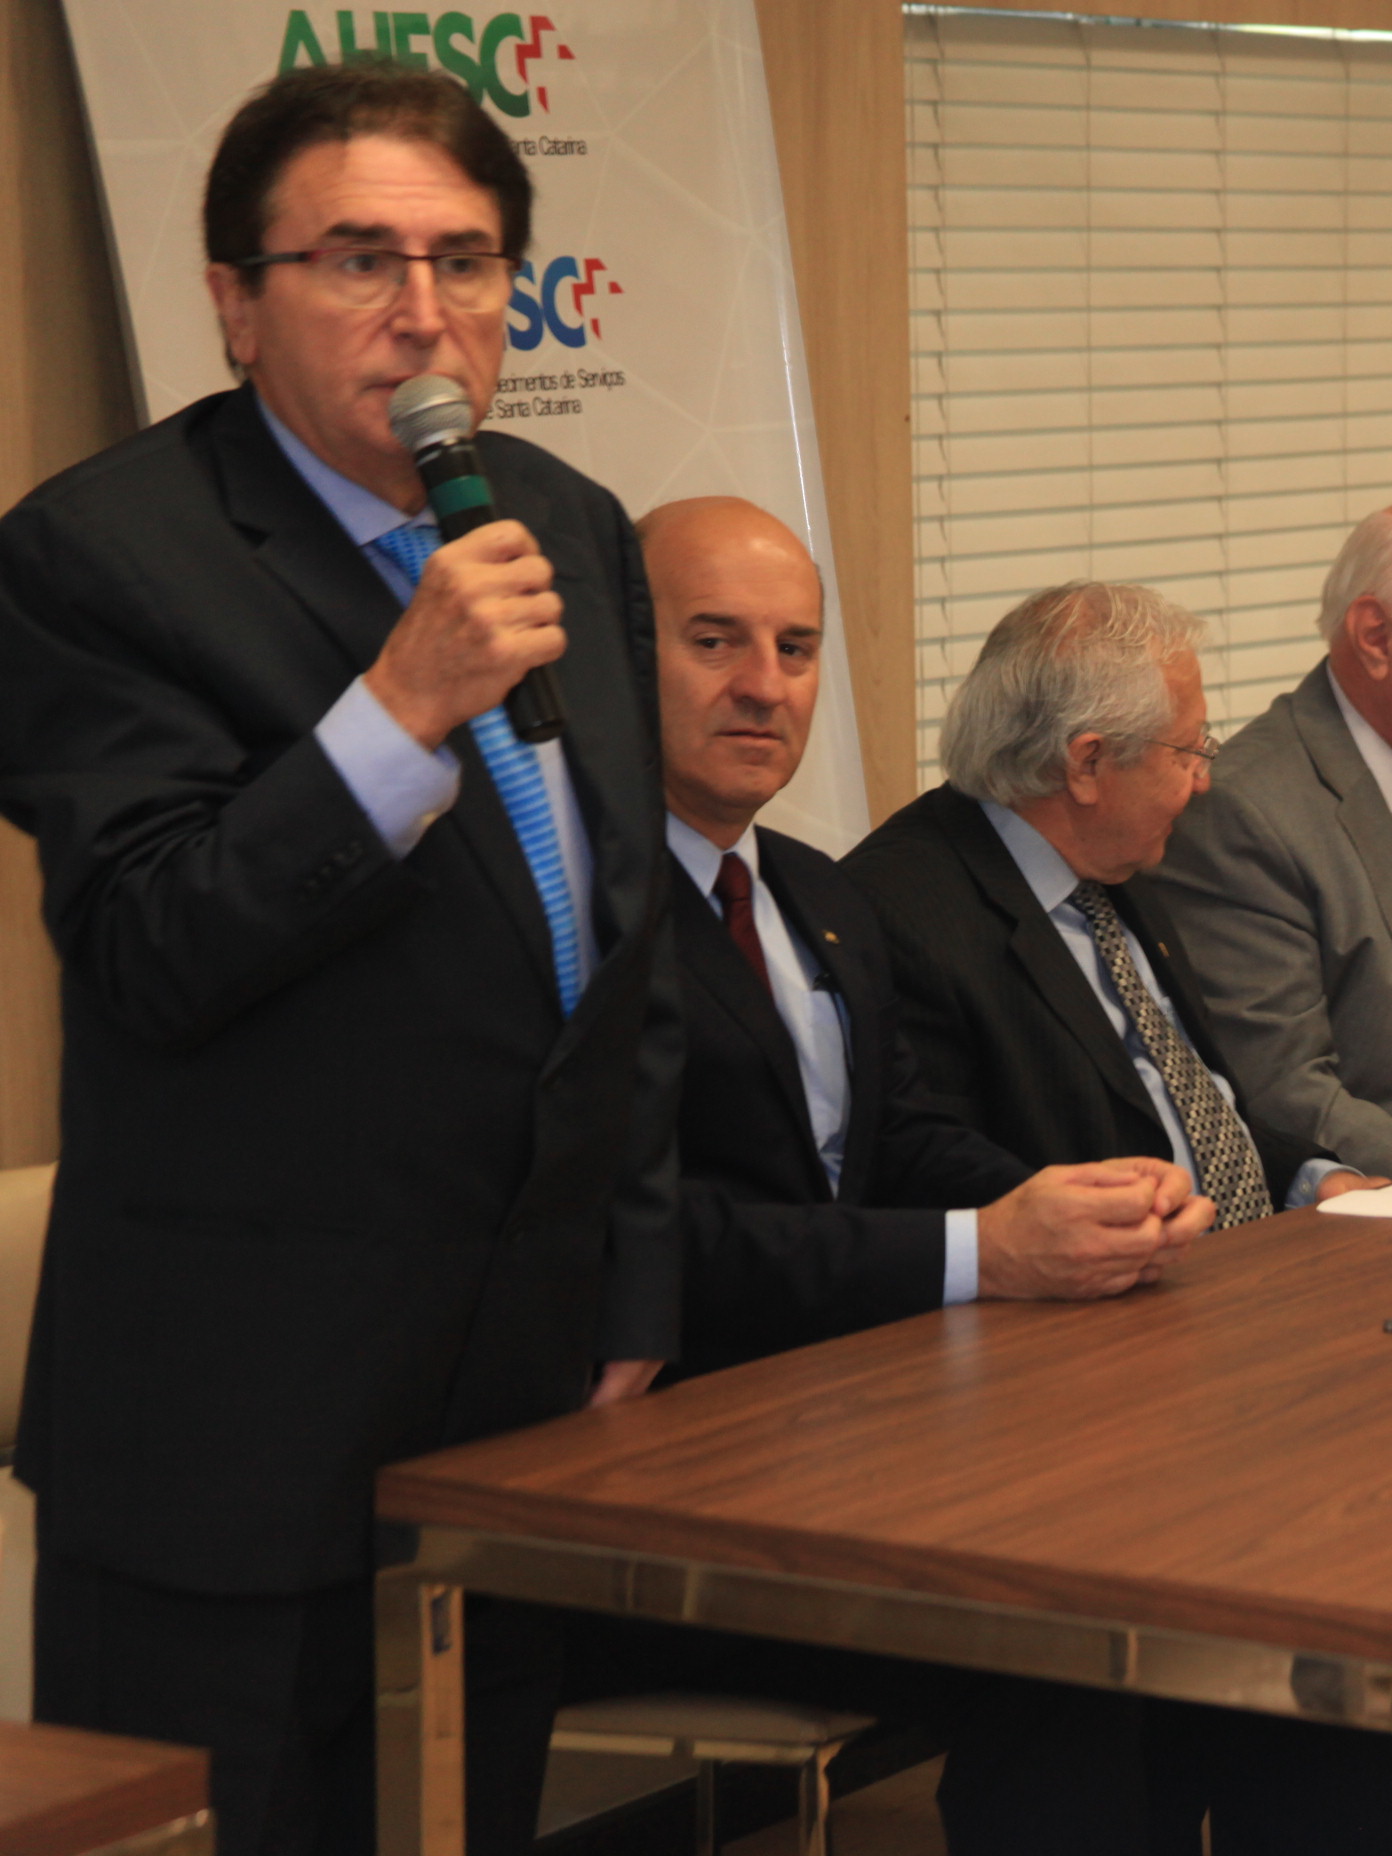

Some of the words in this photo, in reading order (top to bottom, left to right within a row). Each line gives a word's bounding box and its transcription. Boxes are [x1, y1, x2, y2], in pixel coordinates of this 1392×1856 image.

[539, 135, 588, 156] Catarina
[560, 370, 577, 390] de
[577, 368, 626, 392] Serviços
[494, 398, 530, 420] Santa
[532, 396, 582, 417] Catarina
